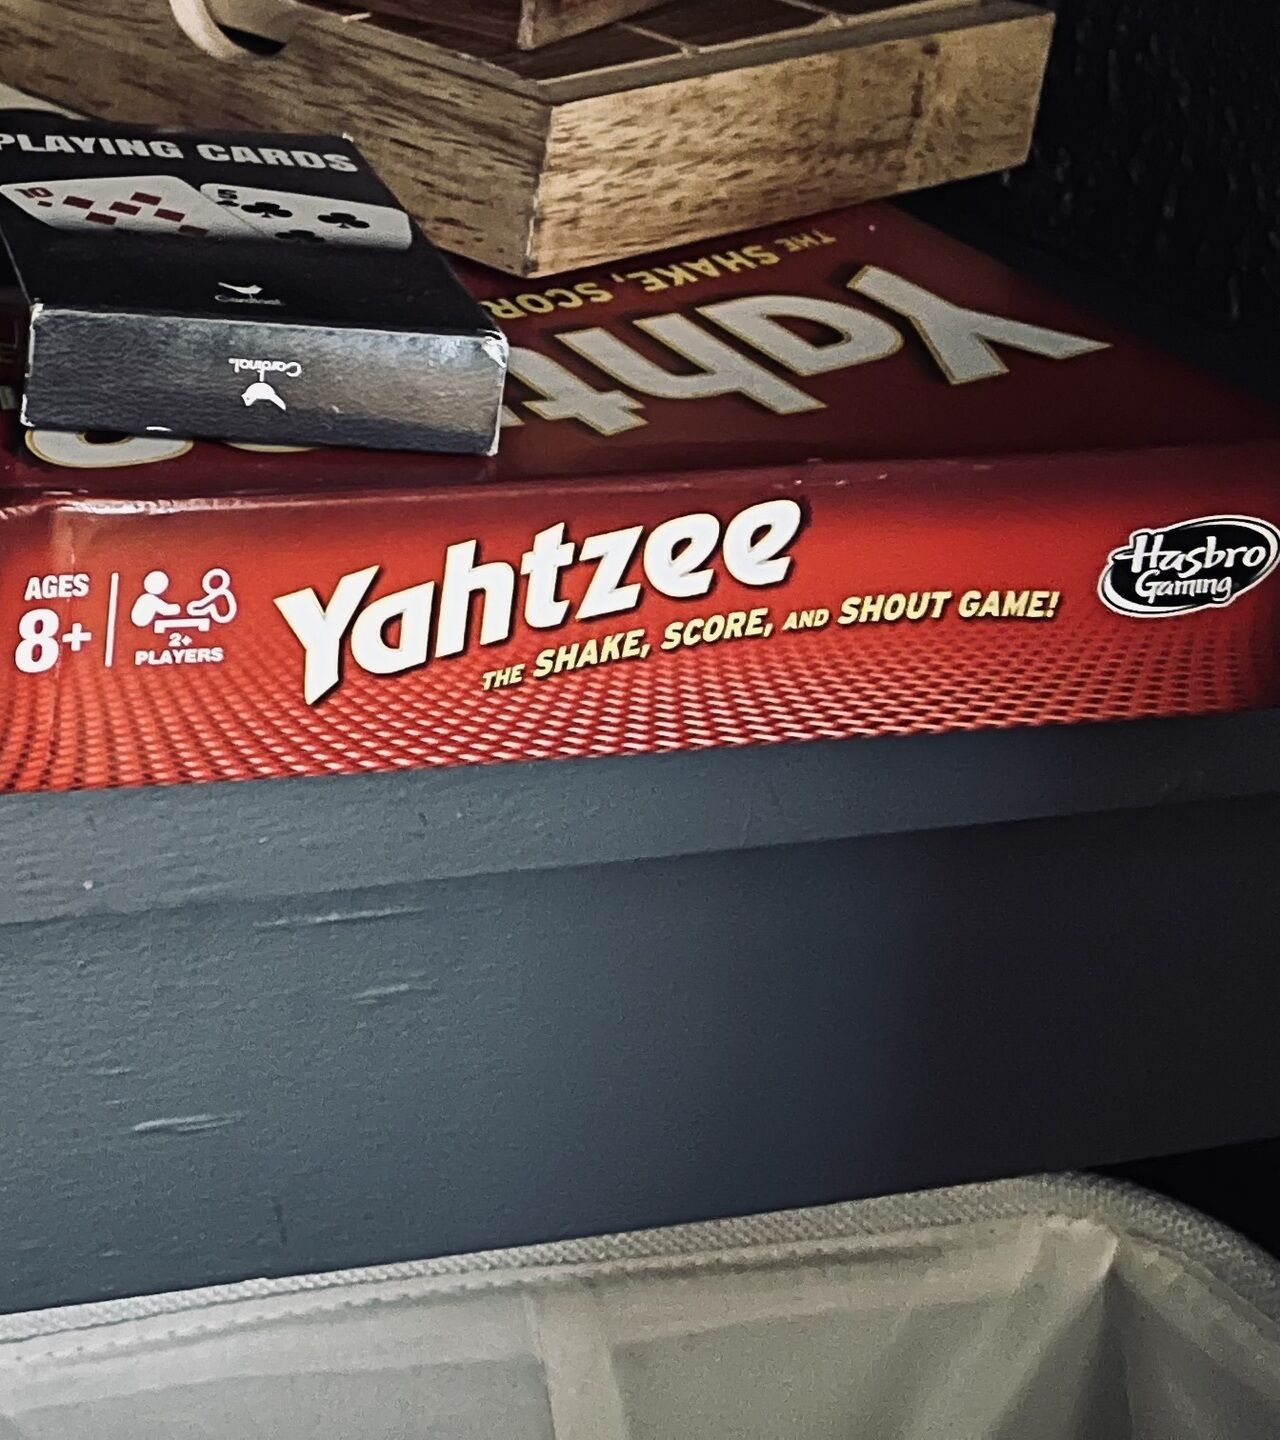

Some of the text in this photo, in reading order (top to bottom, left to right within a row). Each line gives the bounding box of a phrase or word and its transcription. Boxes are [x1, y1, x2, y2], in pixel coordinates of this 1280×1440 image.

[197, 144, 358, 172] CARDS
[15, 187, 54, 199] 10
[217, 189, 237, 199] 5
[480, 230, 836, 319] THE SHAKE, SCOR
[1113, 534, 1267, 578] Hasbro
[24, 573, 90, 600] AGES
[1135, 569, 1233, 604] Gaming
[273, 499, 801, 706] Yahtzee
[15, 608, 92, 673] 8+
[168, 632, 192, 647] 2+
[482, 590, 1060, 690] THE SHAKE, SCORE, AND SHOUT GAME!
[135, 647, 224, 665] PLAYERS
